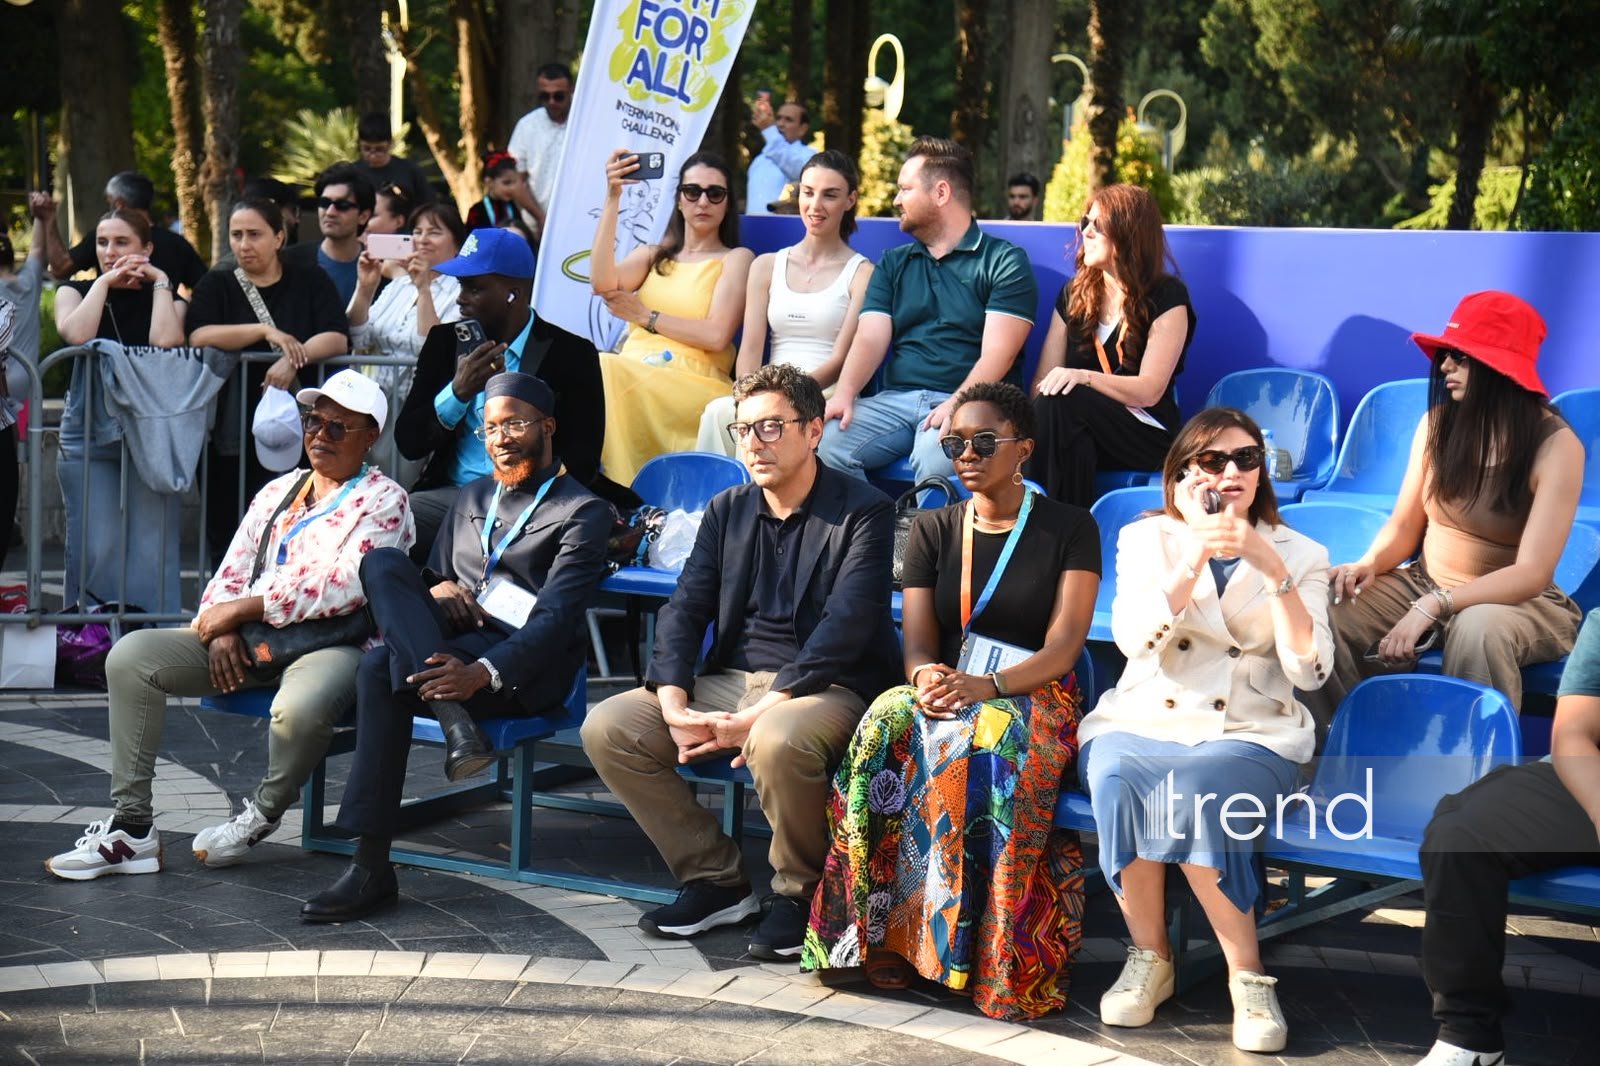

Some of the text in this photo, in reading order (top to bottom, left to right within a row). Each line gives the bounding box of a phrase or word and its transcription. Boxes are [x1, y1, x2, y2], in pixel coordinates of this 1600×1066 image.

[634, 0, 709, 61] FOR
[626, 48, 691, 104] ALL
[616, 99, 681, 136] INTERNATION
[622, 118, 676, 146] CHALLENG
